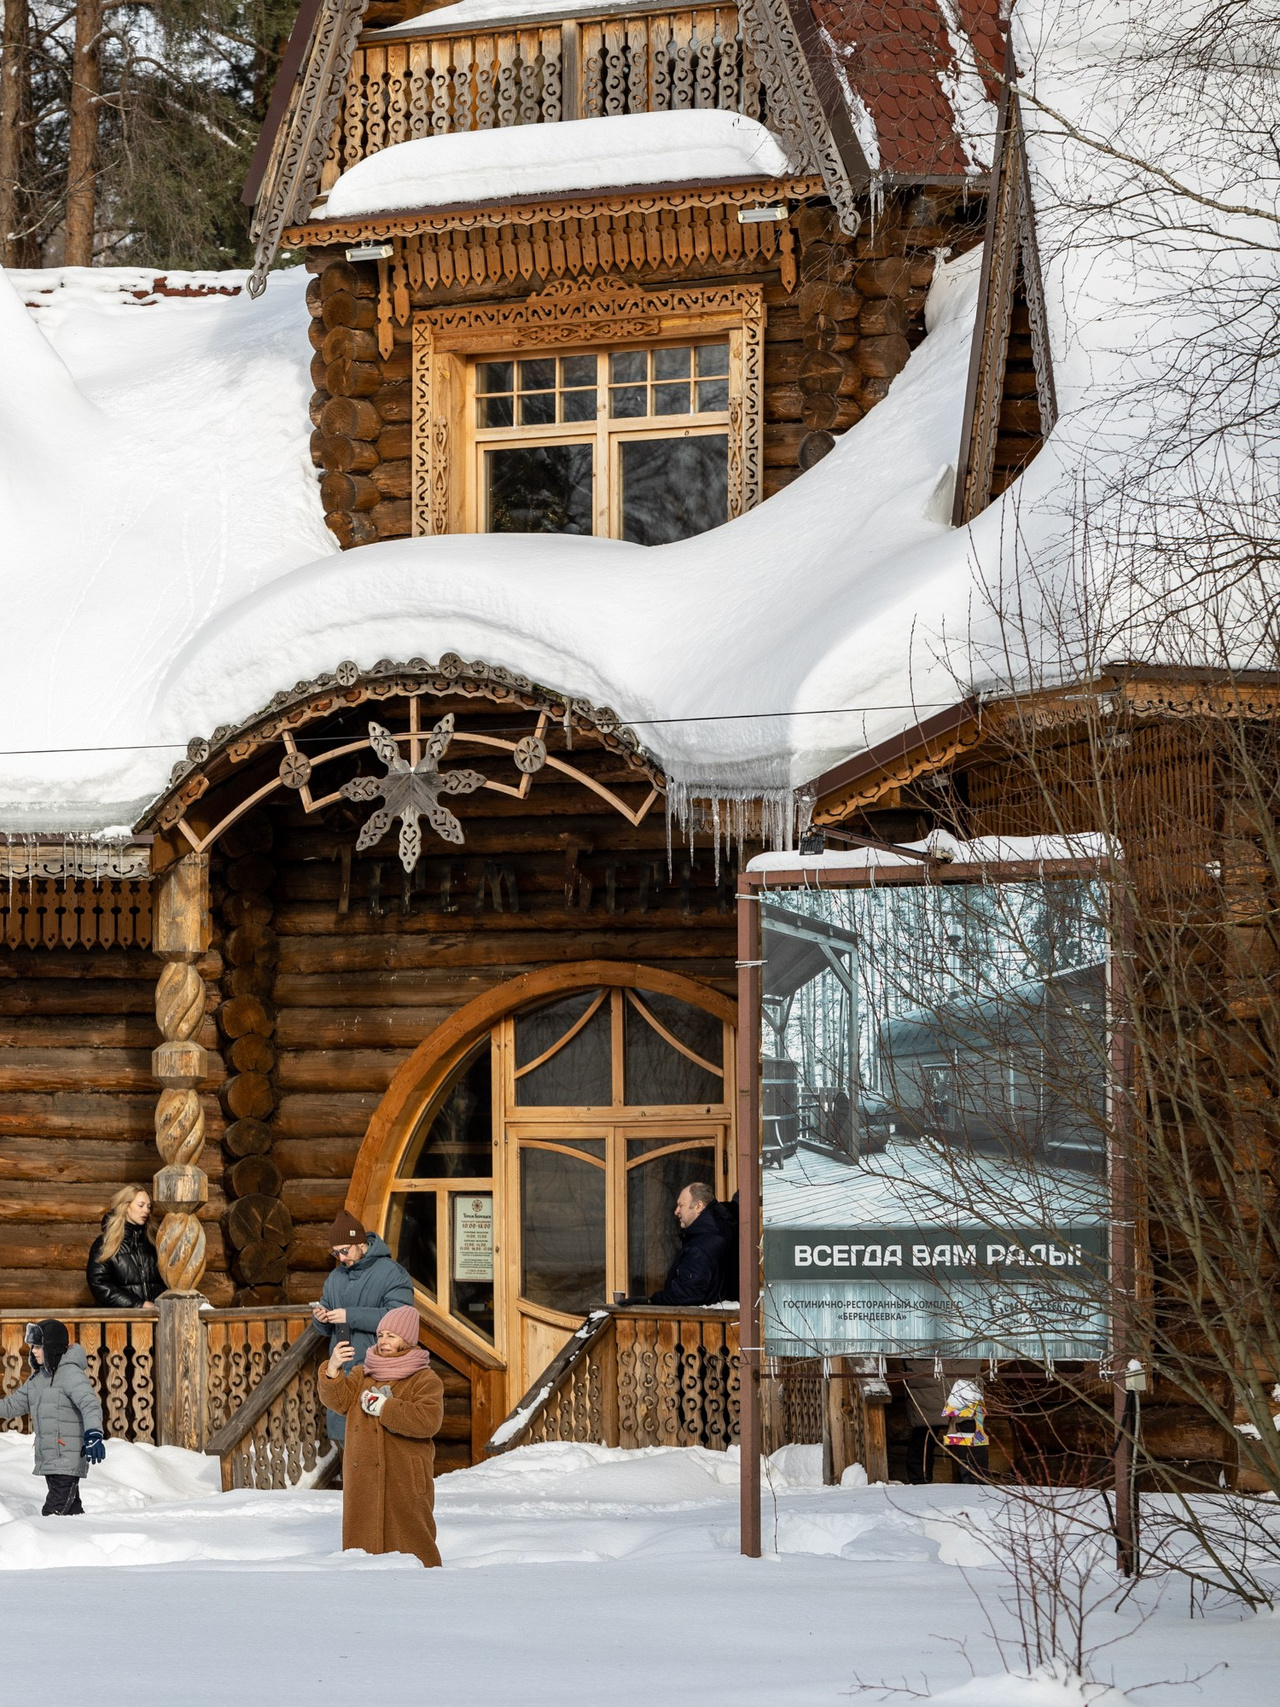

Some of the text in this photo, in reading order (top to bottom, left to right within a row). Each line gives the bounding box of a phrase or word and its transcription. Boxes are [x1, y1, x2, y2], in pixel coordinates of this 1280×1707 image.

[794, 1244, 903, 1267] ВСЕГДА
[912, 1244, 977, 1267] ВАМ
[782, 1298, 911, 1310] ГОСТИНИЧНО-РЕСТОРАННЫЙ
[837, 1312, 908, 1322] «БЕРЕНДЕЕВКА»
